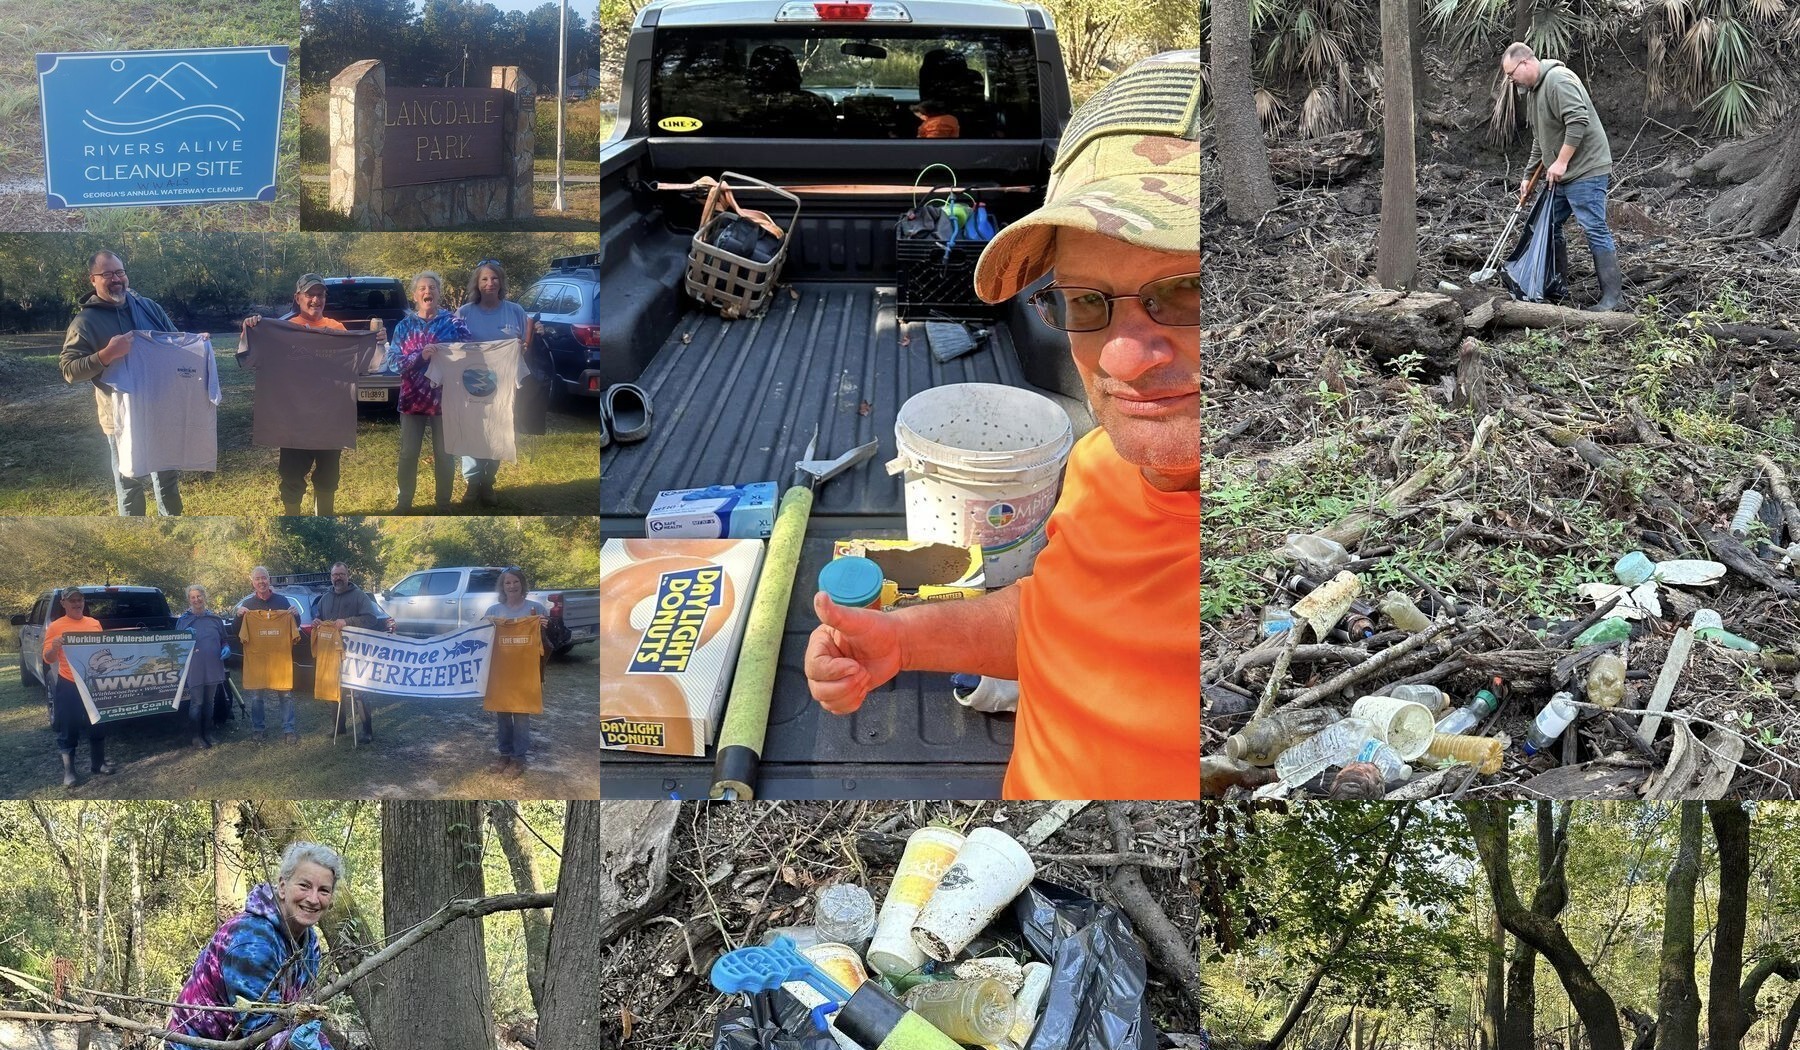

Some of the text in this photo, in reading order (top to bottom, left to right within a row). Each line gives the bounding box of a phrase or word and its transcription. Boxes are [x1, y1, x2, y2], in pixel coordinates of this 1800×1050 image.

[84, 139, 243, 157] RIVERS ALIVE
[416, 134, 475, 162] PARK
[84, 160, 243, 181] CLEANUP SITE
[83, 186, 244, 199] GEORGIA'S ANNUAL WATERWAY CLEANUP
[636, 578, 692, 664] DONUTS
[660, 570, 720, 671] DAYLIGHT
[67, 632, 192, 644] Working For Watershed Conservation
[341, 635, 440, 664] Suwannee
[95, 671, 179, 692] WWALS
[99, 700, 173, 715] ershed Coalit
[600, 722, 662, 735] DAYLIGHT
[607, 732, 660, 746] DONUTS
